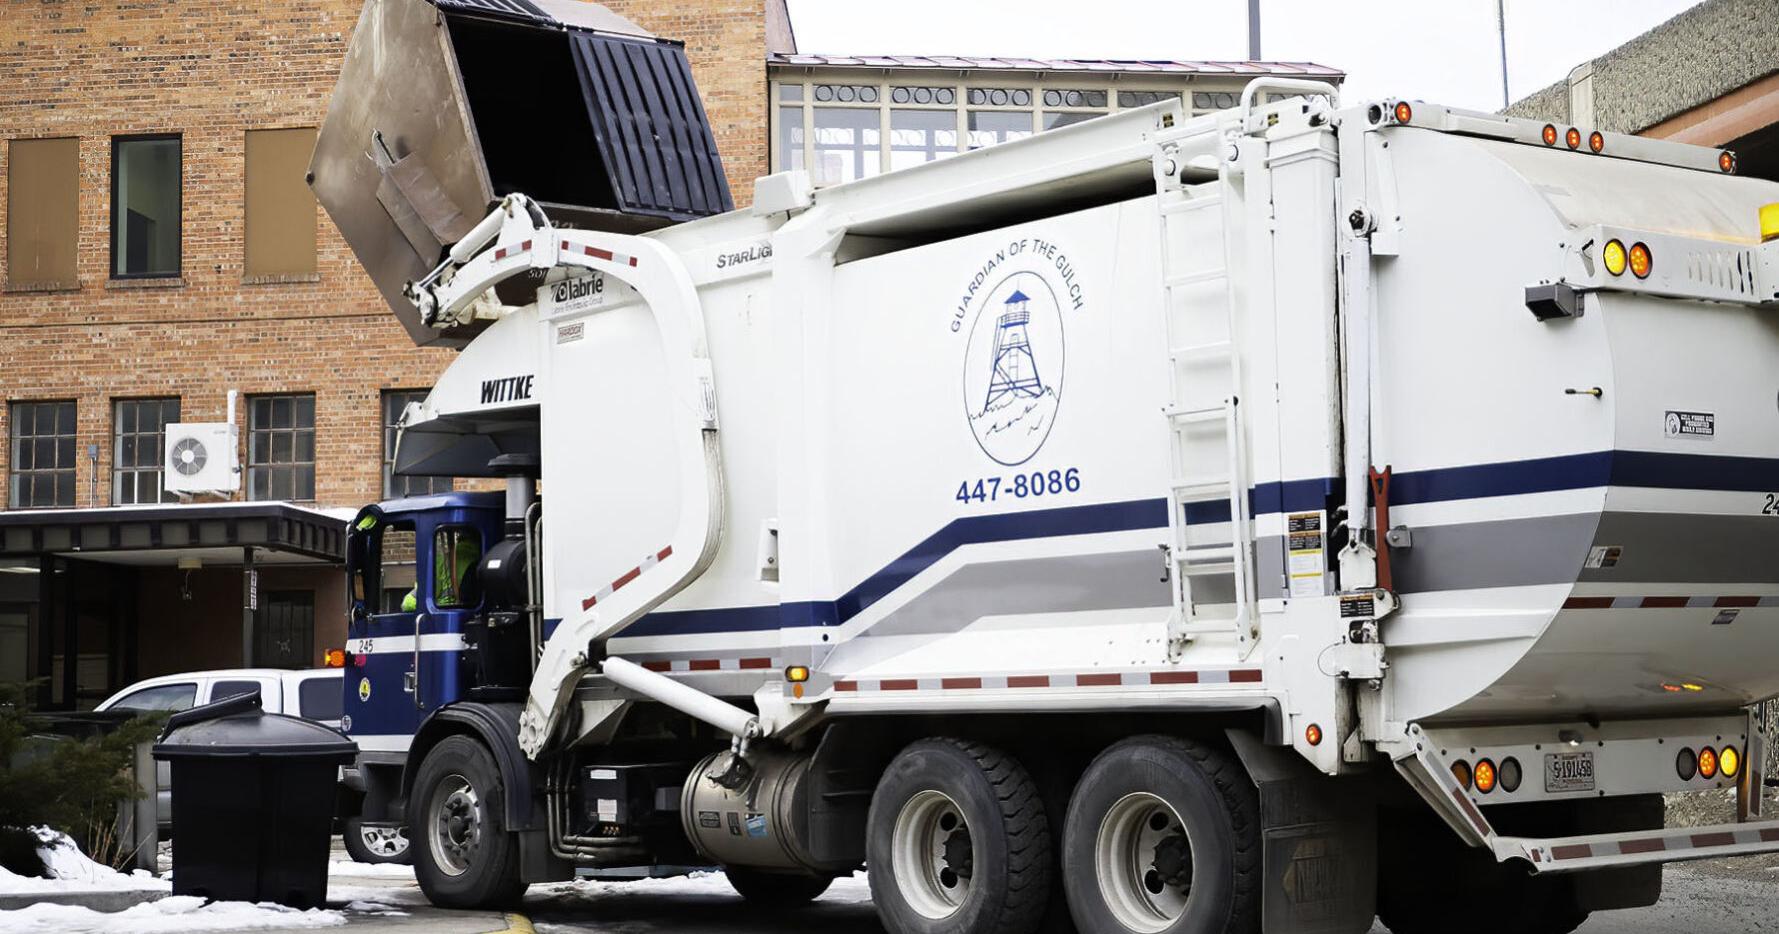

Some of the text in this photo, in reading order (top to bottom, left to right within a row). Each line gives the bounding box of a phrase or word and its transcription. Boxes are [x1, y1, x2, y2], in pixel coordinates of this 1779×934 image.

[568, 273, 604, 300] labrie
[950, 239, 1084, 333] GUARDIAN OF THE GULCH
[481, 374, 535, 404] WITTKE
[956, 467, 1081, 504] 447-8086
[359, 639, 374, 653] 245
